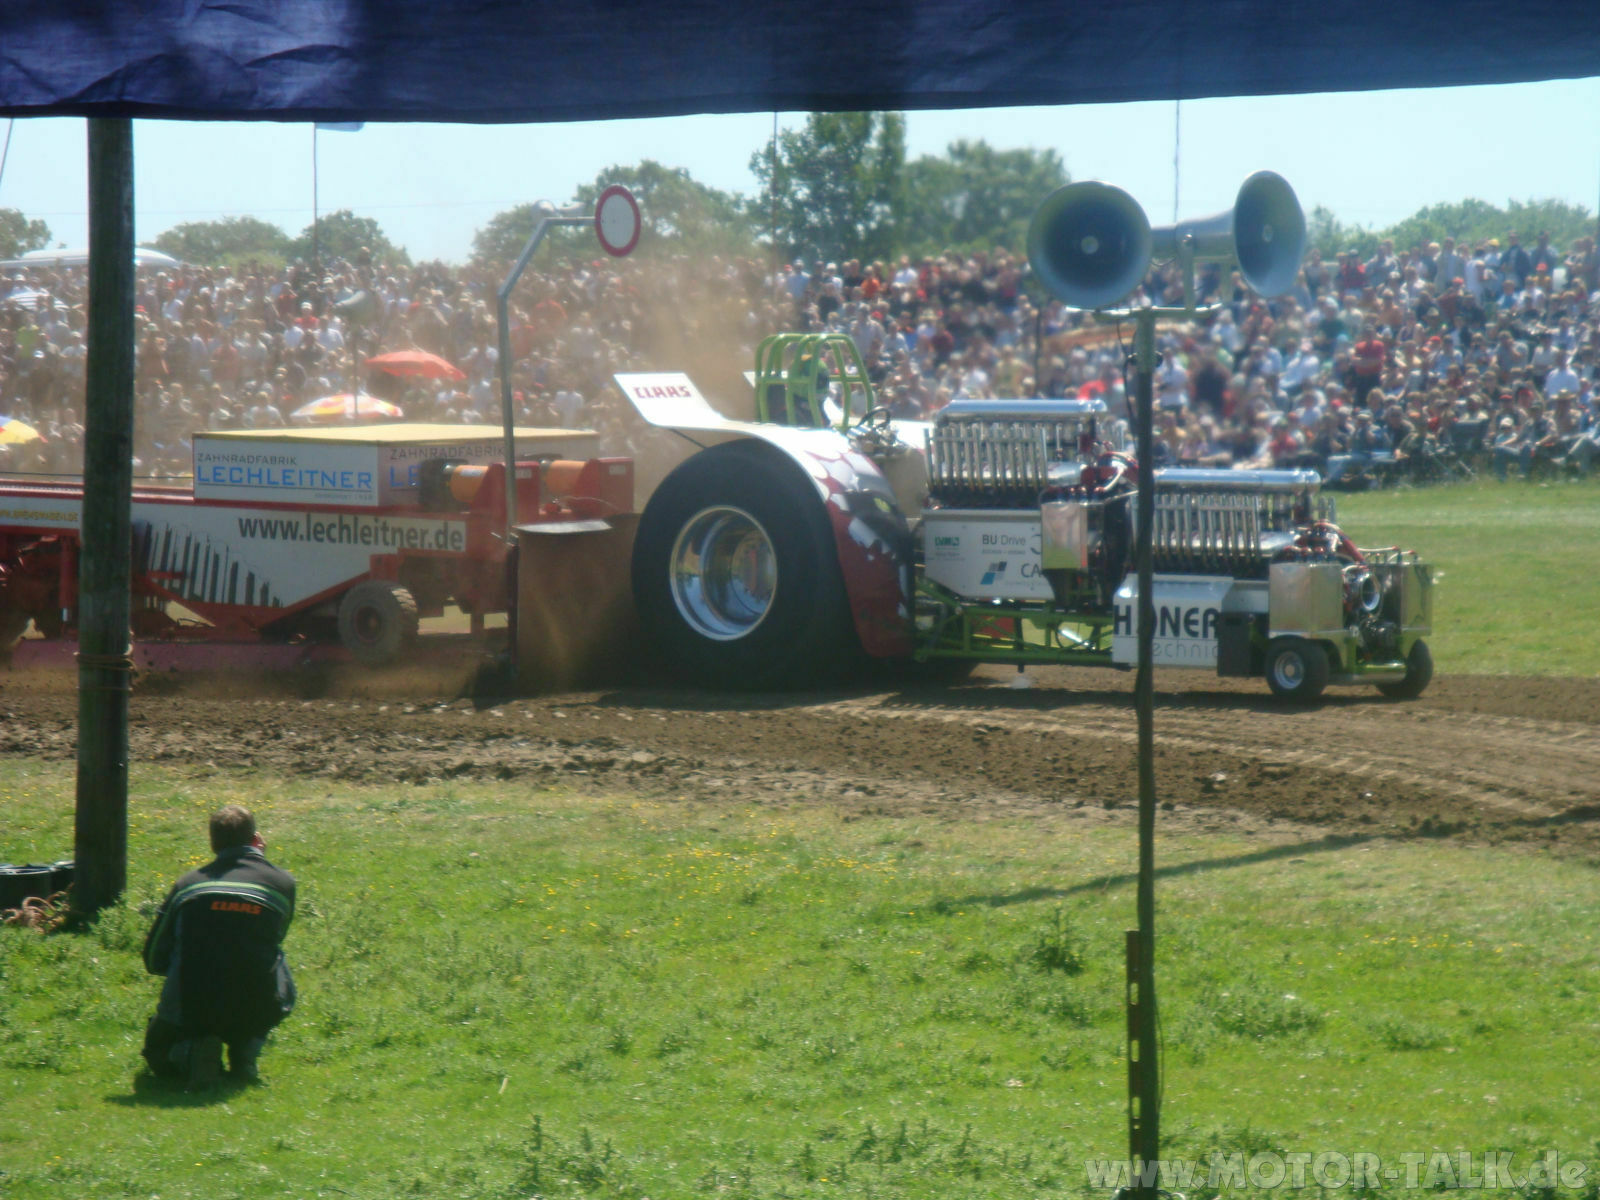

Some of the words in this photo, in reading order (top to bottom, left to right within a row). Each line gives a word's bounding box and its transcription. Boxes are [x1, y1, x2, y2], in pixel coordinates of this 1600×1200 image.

[633, 385, 692, 399] CLAAS
[197, 453, 298, 466] ZAHNRADFABRIK
[197, 465, 373, 490] LECHLEITNER
[238, 513, 464, 550] www.lechleitner.de
